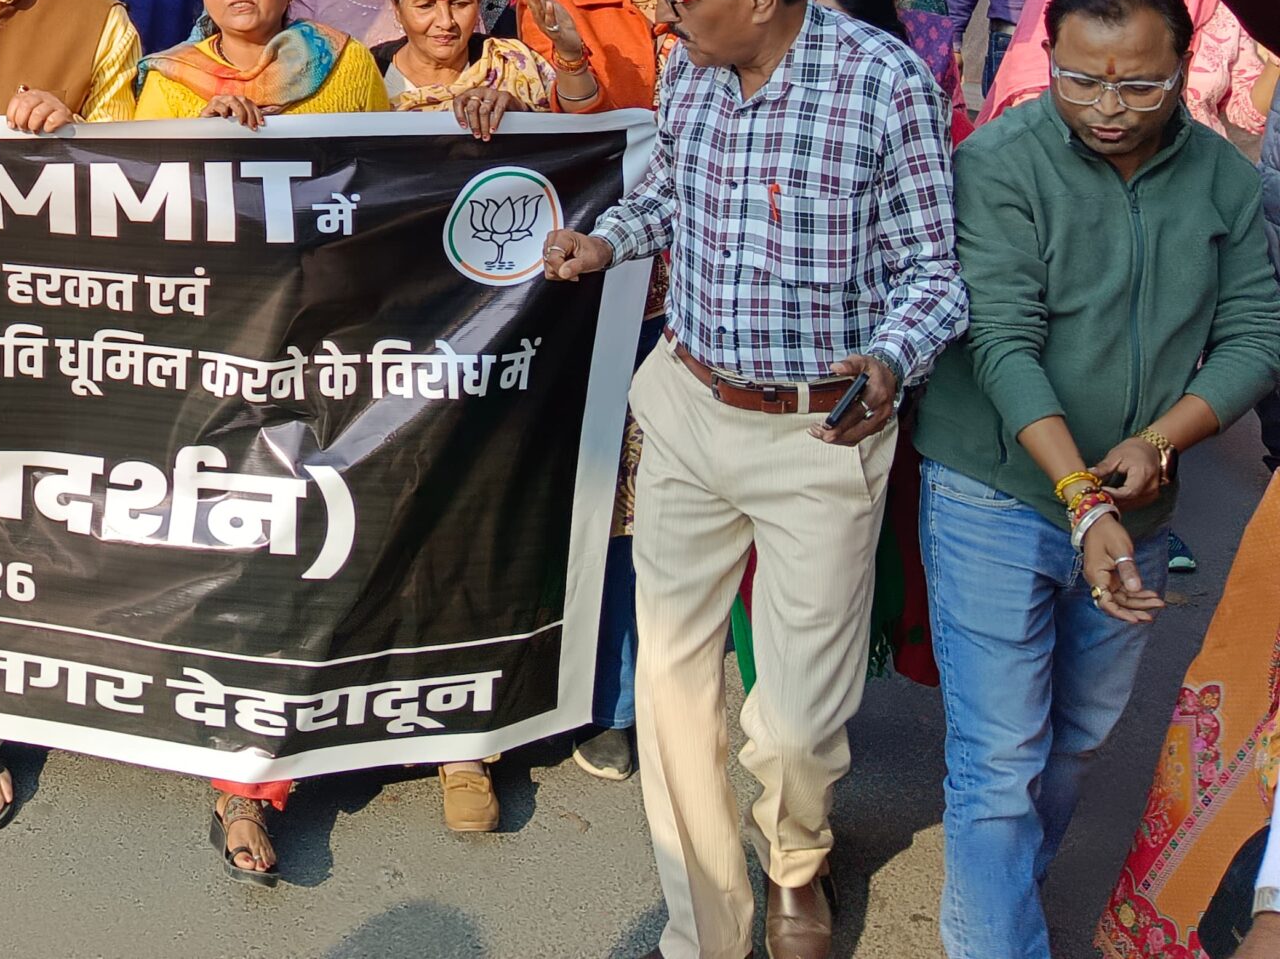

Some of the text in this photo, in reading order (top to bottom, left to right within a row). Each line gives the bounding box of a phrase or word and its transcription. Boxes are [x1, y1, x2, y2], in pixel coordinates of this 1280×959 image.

[313, 191, 358, 237] में
[6, 260, 137, 314] हरकत
[141, 265, 211, 318] एवं
[53, 330, 193, 397] धूमिल
[200, 340, 309, 405] करने
[313, 338, 359, 400] के
[366, 337, 494, 401] विरोध
[497, 335, 542, 391] में
[166, 665, 504, 739] देहरादून
